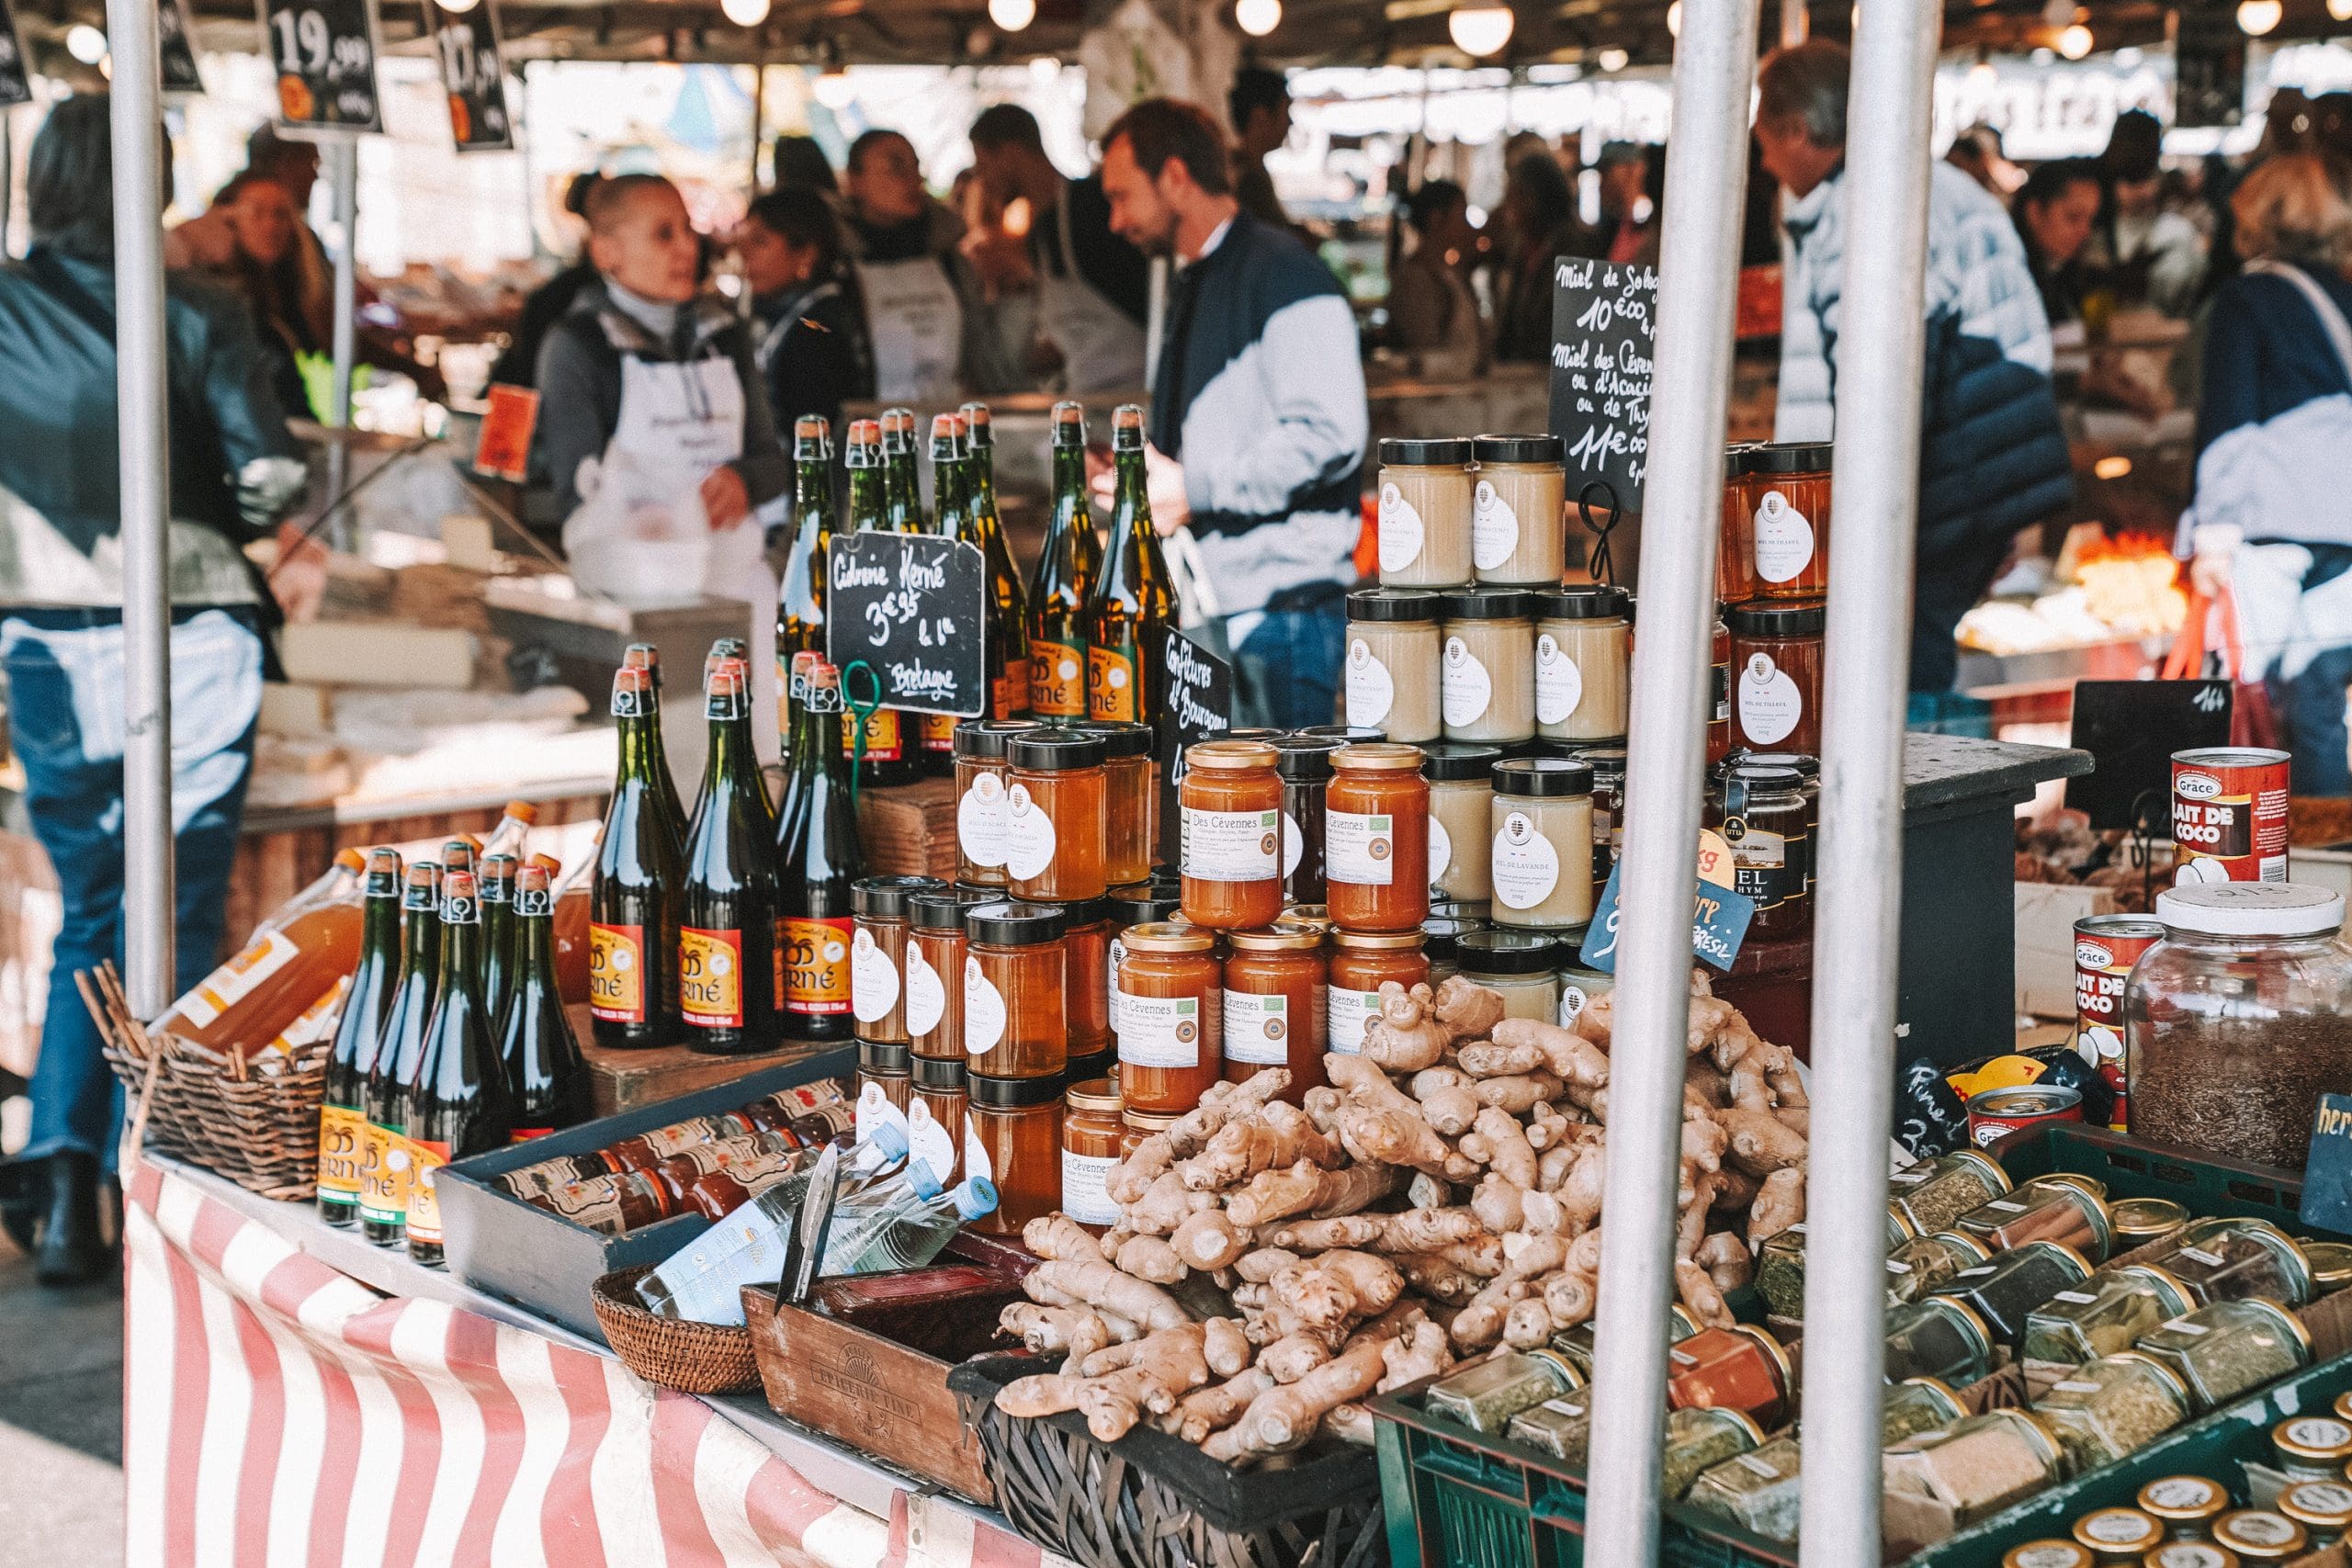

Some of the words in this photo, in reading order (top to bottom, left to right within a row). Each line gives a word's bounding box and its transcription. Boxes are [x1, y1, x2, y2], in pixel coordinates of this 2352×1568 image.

[1555, 259, 1595, 290] Miel
[1602, 265, 1619, 288] de
[1553, 339, 1589, 369] Miel
[1594, 343, 1615, 371] des
[1572, 374, 1589, 391] ou
[1577, 397, 1594, 413] ou
[1603, 396, 1622, 418] de
[2179, 781, 2213, 794] Grace
[1193, 814, 1208, 828] Des
[1211, 816, 1258, 829] Cévennes
[2205, 807, 2235, 826] DE
[2176, 822, 2221, 844] COCO
[1517, 862, 1551, 871] LAVANDE
[2077, 949, 2106, 964] Grace
[2098, 976, 2126, 997] DE
[1129, 999, 1171, 1015] Cévennes
